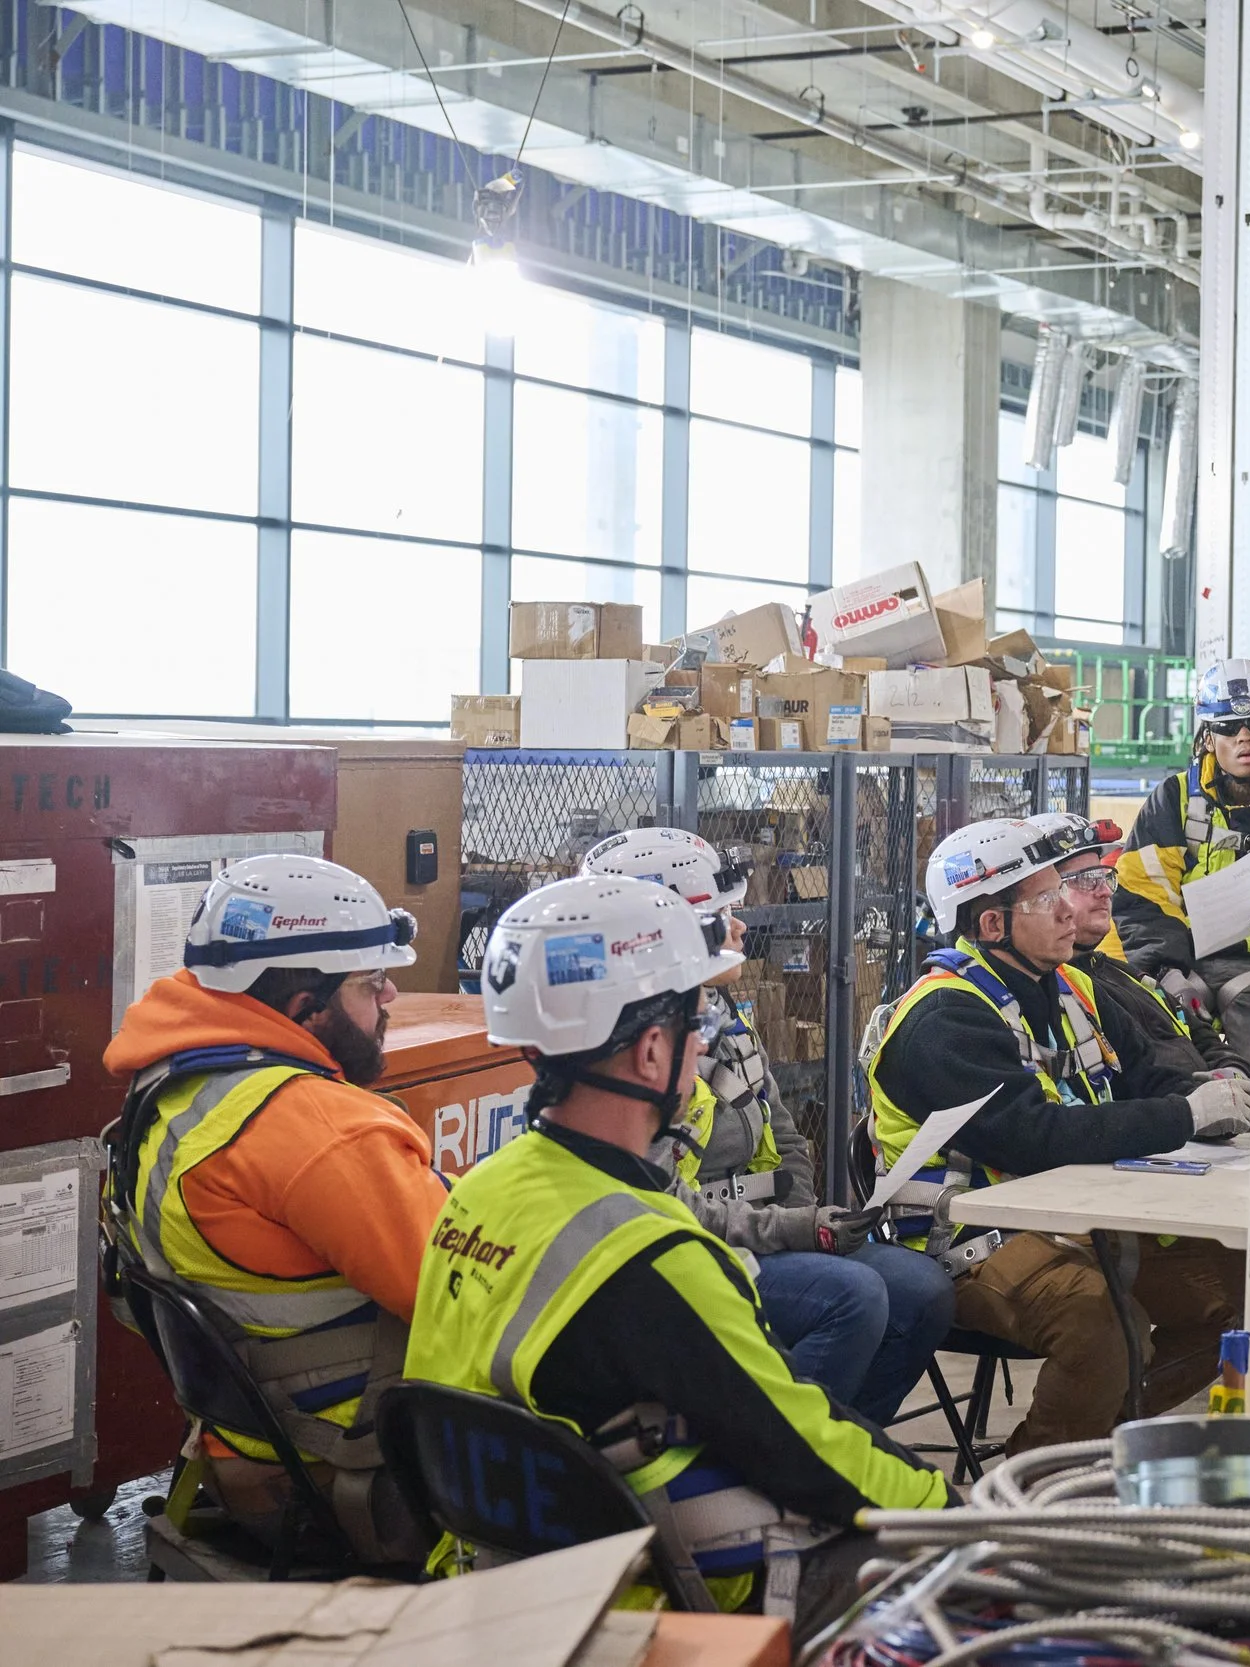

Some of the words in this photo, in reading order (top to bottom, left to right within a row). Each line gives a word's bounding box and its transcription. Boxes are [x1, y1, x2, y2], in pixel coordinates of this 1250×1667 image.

[272, 915, 328, 931] Gephart
[432, 1216, 517, 1271] Gephart
[441, 1418, 578, 1547] ICE
